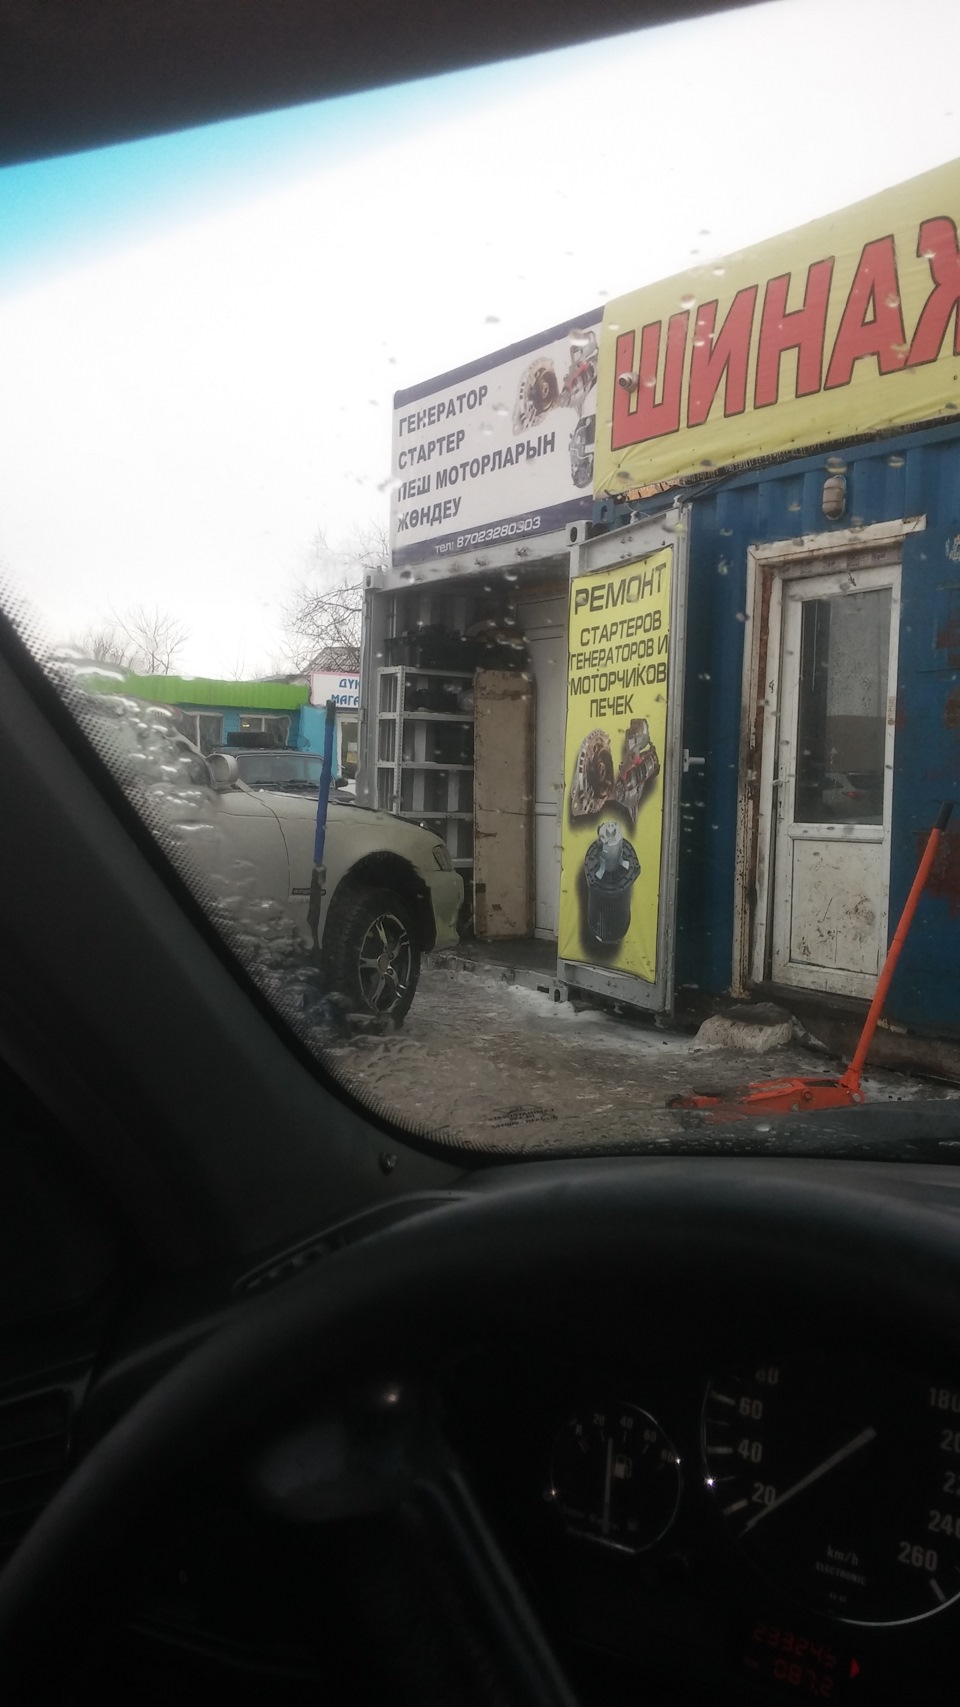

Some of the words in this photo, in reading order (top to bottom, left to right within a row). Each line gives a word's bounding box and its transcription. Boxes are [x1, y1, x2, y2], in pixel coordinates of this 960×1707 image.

[399, 385, 489, 437] ГЕНЕРАТОР
[398, 475, 431, 502] ПЕШ
[436, 431, 556, 491] МОТОРЛАРЫН
[399, 429, 466, 470] СТАРТЕР
[397, 496, 462, 532] ЖӨНДЕУ
[575, 563, 667, 615] РЕМОНТ
[580, 609, 662, 647] СТАРТЕРОВ
[570, 637, 654, 671] ГЕНЕРАТОРОВ
[658, 634, 668, 655] И
[570, 662, 667, 696] МОТОРЧИКОВ
[590, 694, 634, 718] ПЕЧЕК
[739, 1396, 763, 1420] 60
[737, 1438, 763, 1463] 40
[752, 1482, 777, 1505] 20
[826, 1544, 859, 1567] km/h
[897, 1541, 938, 1573] 260
